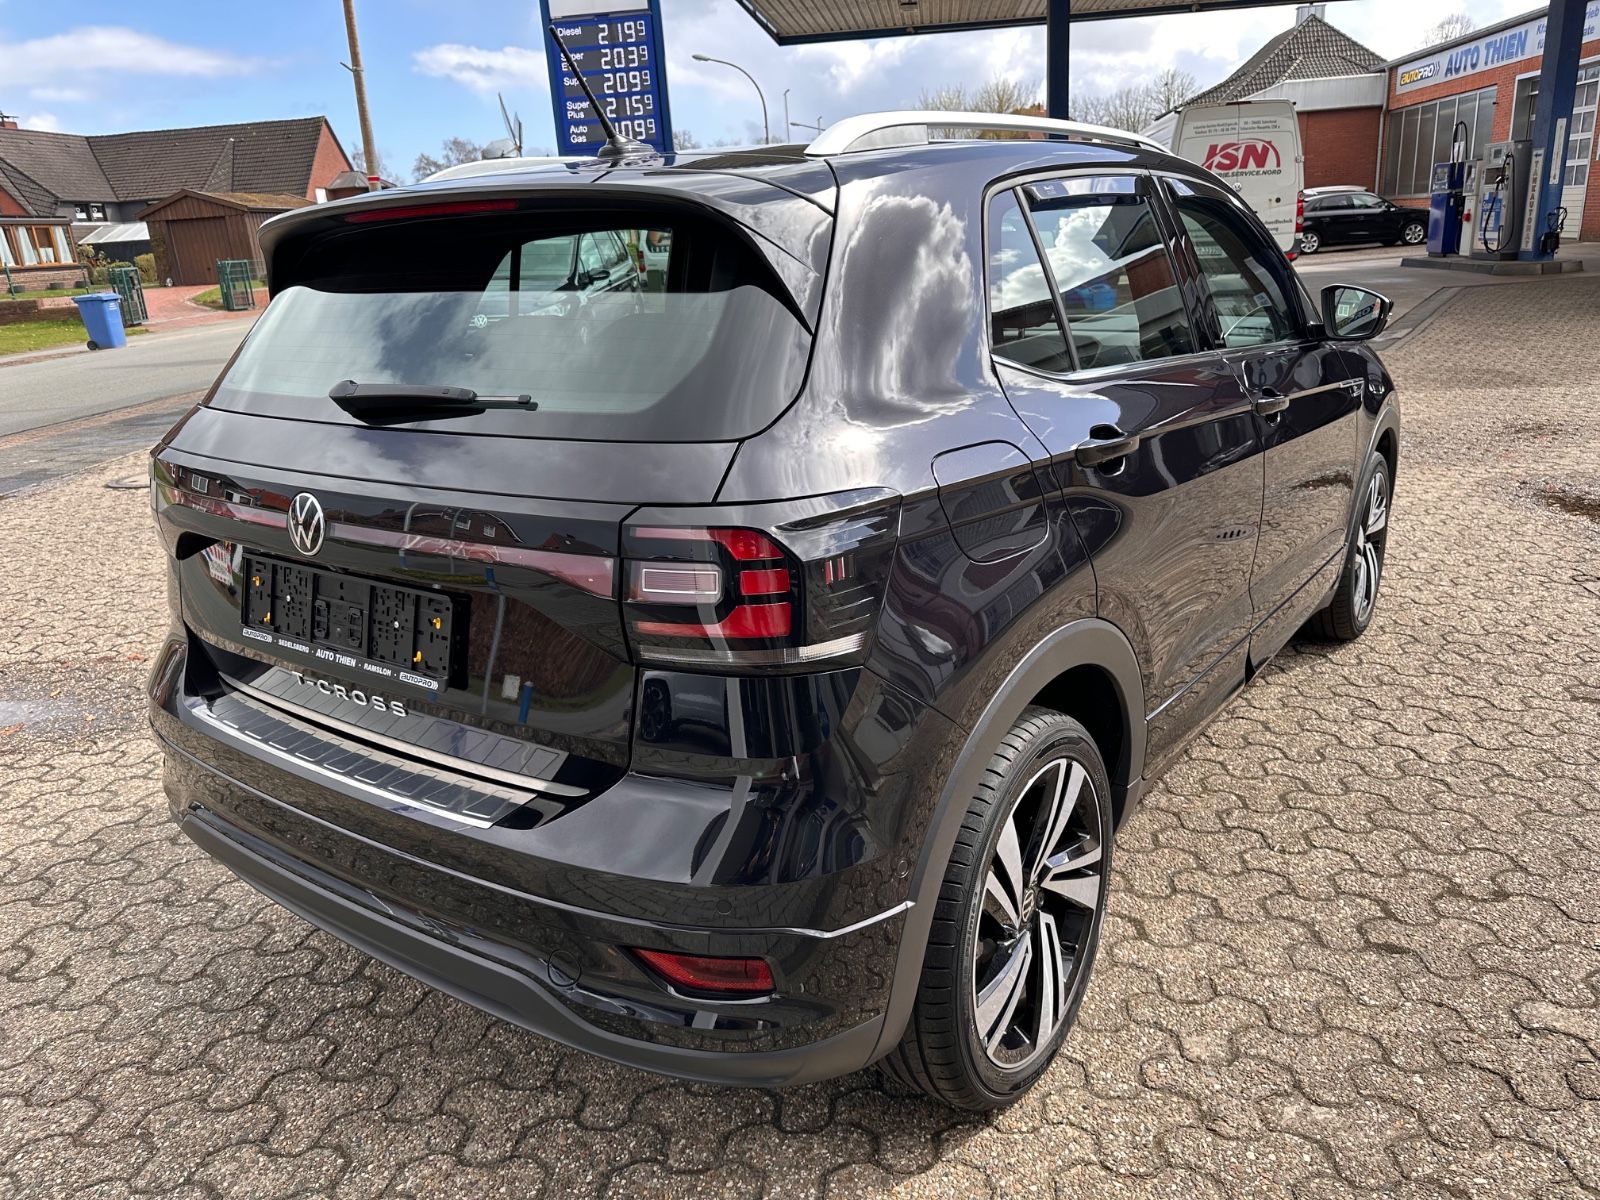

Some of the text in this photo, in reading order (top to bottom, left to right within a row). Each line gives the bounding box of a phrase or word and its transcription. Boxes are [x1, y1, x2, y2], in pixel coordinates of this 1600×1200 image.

[557, 27, 582, 36] Diesel
[560, 52, 584, 62] Sper
[1445, 46, 1481, 76] AUTO
[1485, 30, 1528, 65] THIEN
[563, 77, 587, 87] Supr
[566, 101, 590, 111] Super
[567, 110, 585, 119] Plus
[569, 125, 588, 133] Auto
[570, 133, 587, 143] Gas
[1202, 143, 1271, 170] ISN
[278, 639, 310, 654] SEDELSBERG
[316, 649, 335, 661] AUTO
[335, 654, 357, 668] THIEN
[363, 664, 392, 677] RAMSLOH
[290, 671, 408, 717] T-CROSS
